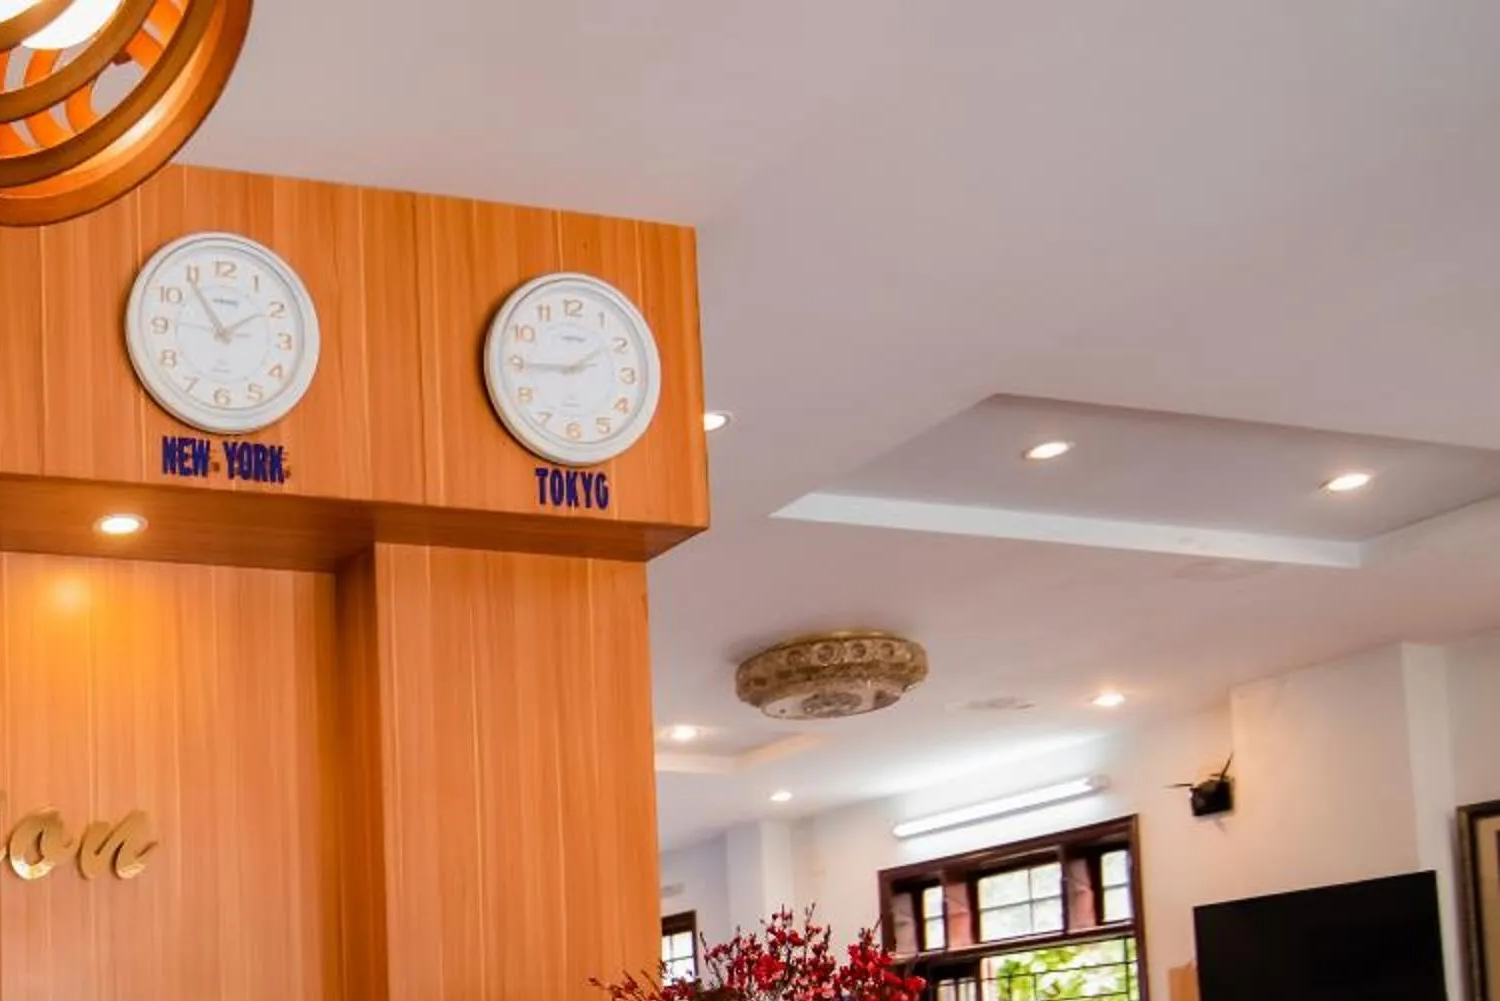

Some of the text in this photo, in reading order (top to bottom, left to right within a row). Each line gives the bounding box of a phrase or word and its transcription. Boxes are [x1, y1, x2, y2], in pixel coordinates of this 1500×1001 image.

[212, 261, 237, 279] 12
[159, 286, 183, 304] 10
[269, 301, 285, 318] 2
[151, 317, 169, 334] 9
[277, 333, 292, 350] 3
[160, 350, 177, 368] 8
[269, 364, 283, 379] 4
[183, 377, 199, 394] 7
[247, 384, 263, 401] 5
[213, 389, 230, 406] 6
[162, 435, 285, 484] NEW YORK
